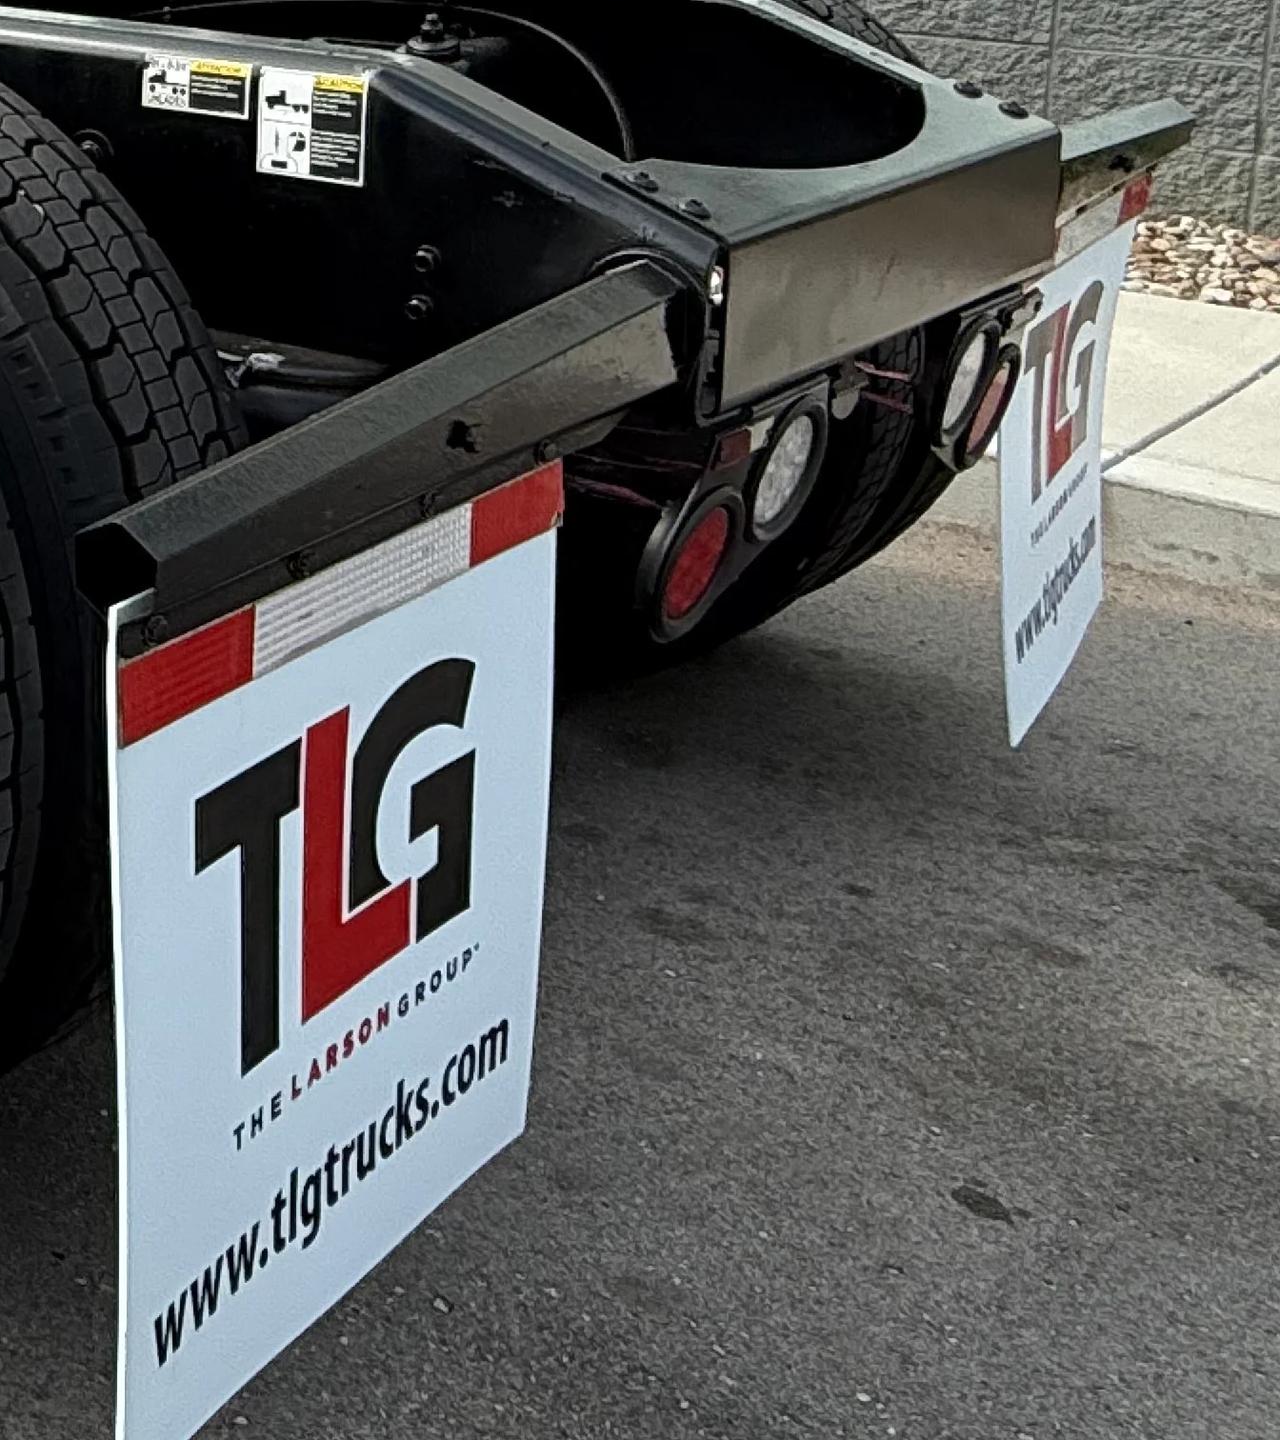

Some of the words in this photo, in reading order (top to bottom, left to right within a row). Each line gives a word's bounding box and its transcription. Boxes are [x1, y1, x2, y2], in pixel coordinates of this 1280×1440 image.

[1023, 280, 1104, 506] TLG
[194, 656, 476, 1078] TLG
[153, 1013, 510, 1368] www.tlgtrucks.com
[232, 1090, 282, 1152] THE
[290, 1001, 391, 1101] LARSON
[397, 947, 474, 1017] GROUP
